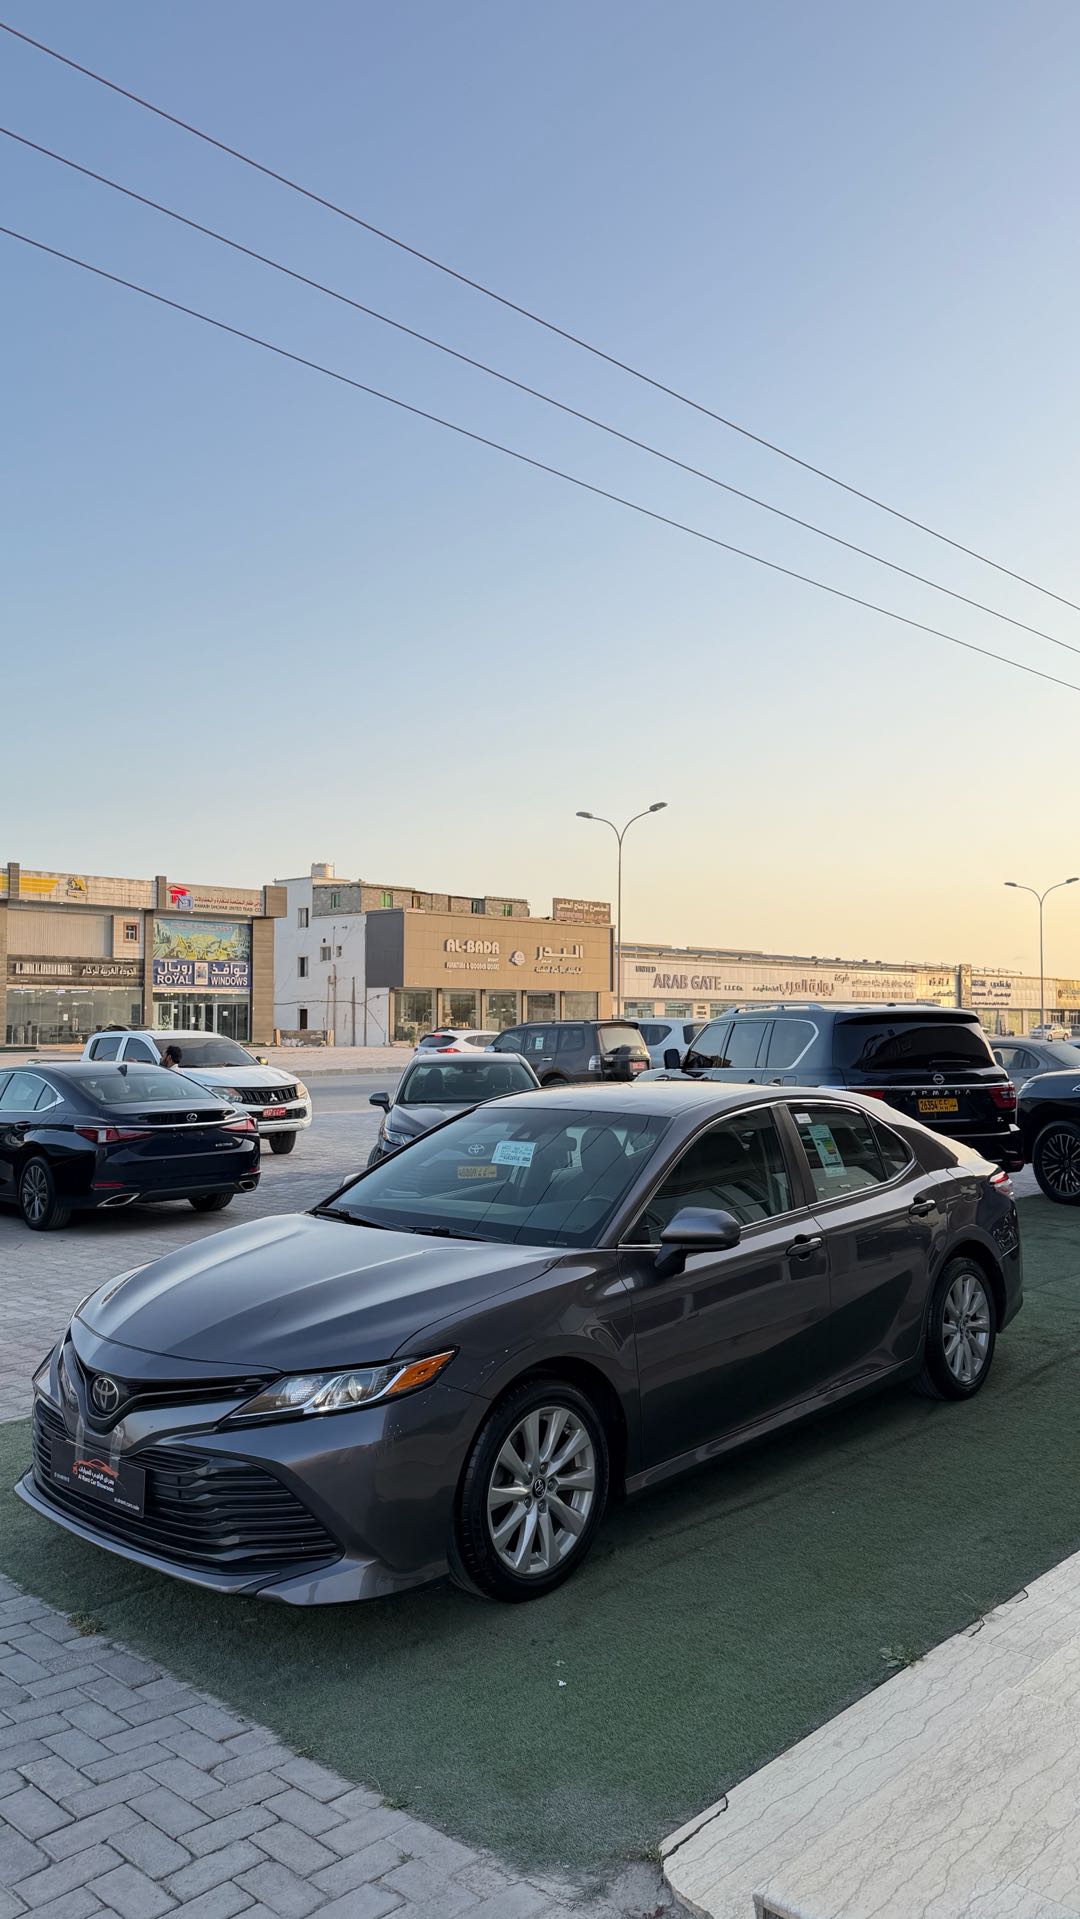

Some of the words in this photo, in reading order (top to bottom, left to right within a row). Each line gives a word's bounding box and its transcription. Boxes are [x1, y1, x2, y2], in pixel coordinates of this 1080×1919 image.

[446, 938, 500, 954] AL-BADR
[536, 944, 584, 962] البدر
[157, 961, 192, 976] رويال
[211, 962, 248, 978] نوافذ
[157, 975, 192, 985] ROYAL
[210, 976, 248, 986] WINDOWS
[653, 973, 688, 990] ARAB
[690, 975, 722, 991] GATE
[911, 1089, 972, 1097] ARMADA
